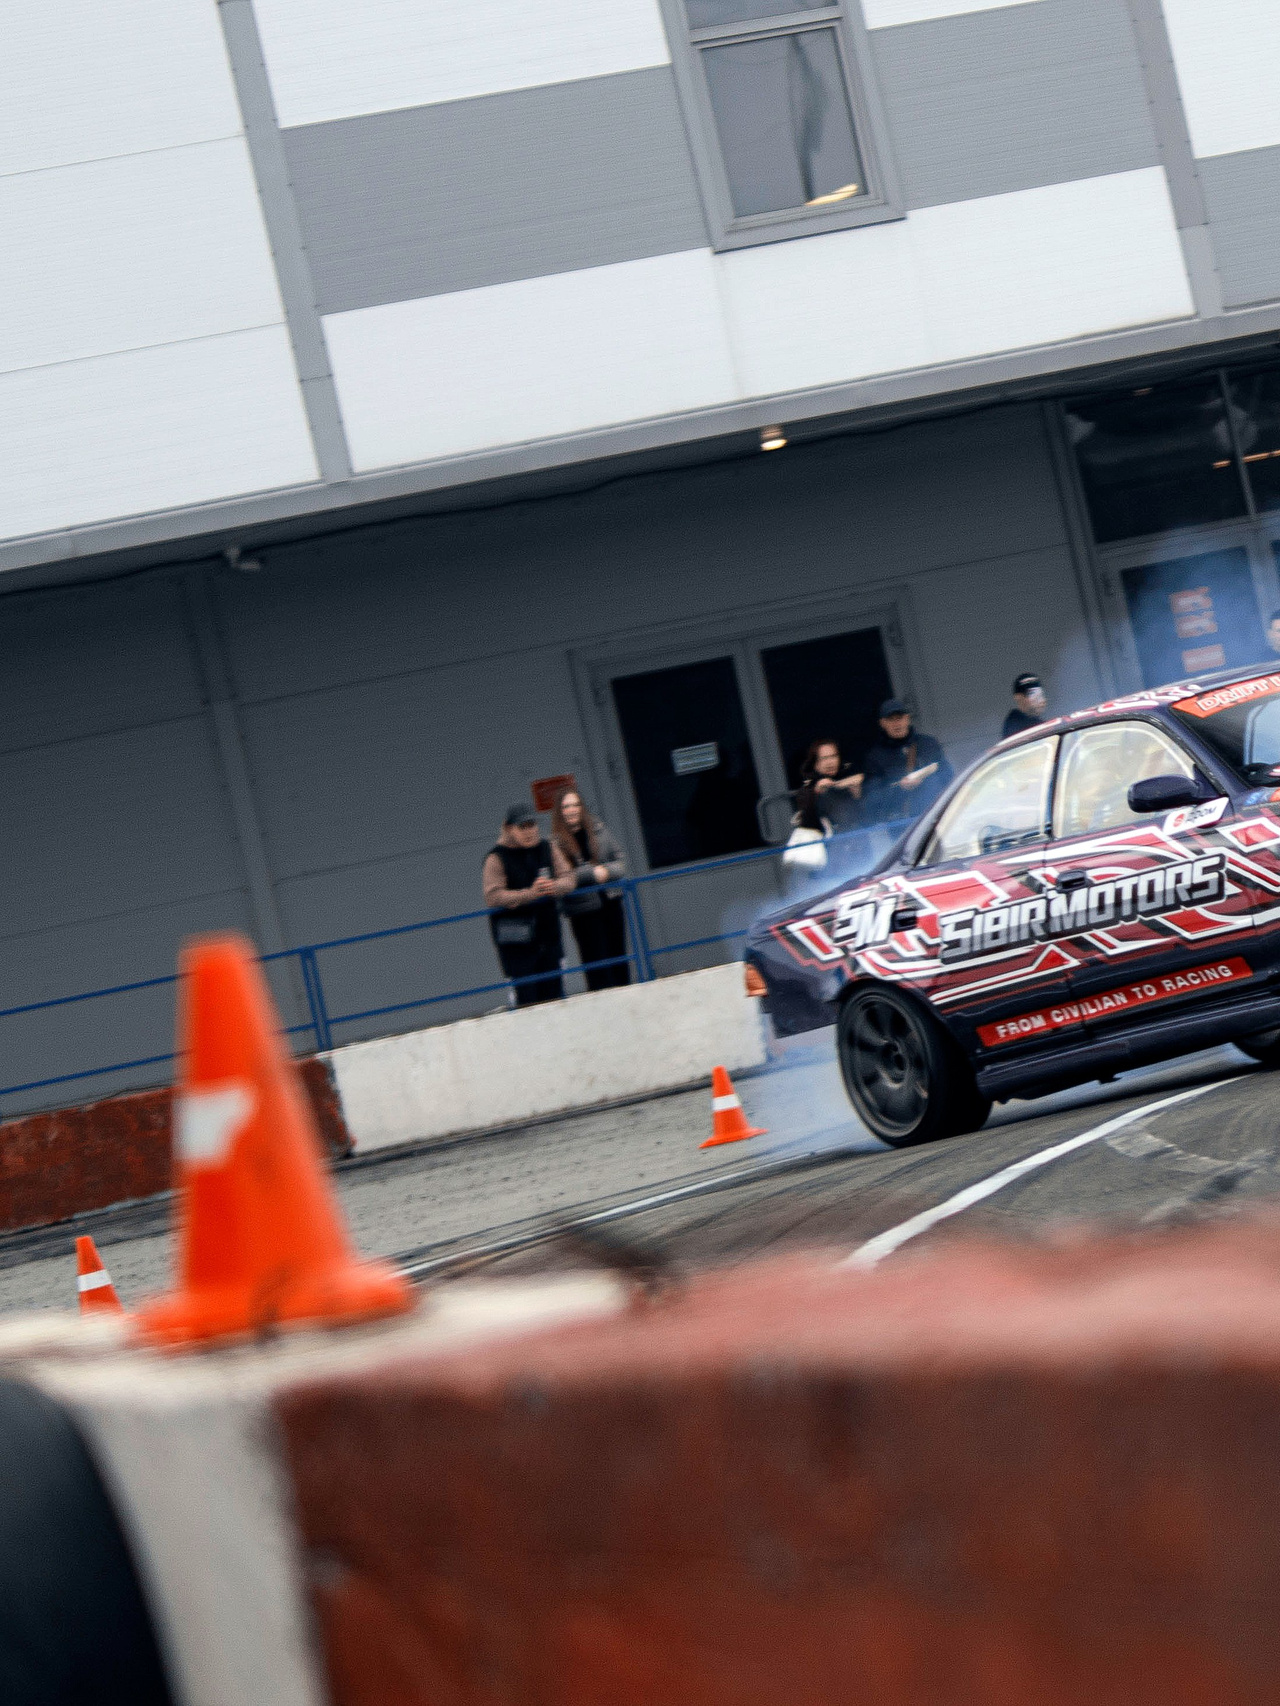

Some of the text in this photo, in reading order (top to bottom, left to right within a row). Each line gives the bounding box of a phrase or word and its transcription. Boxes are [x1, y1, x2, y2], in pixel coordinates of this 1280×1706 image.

[1196, 681, 1270, 711] DRIFT
[1047, 856, 1224, 933] MOTORS
[995, 965, 1233, 1038] FROM CIVILIAN TO RACING
